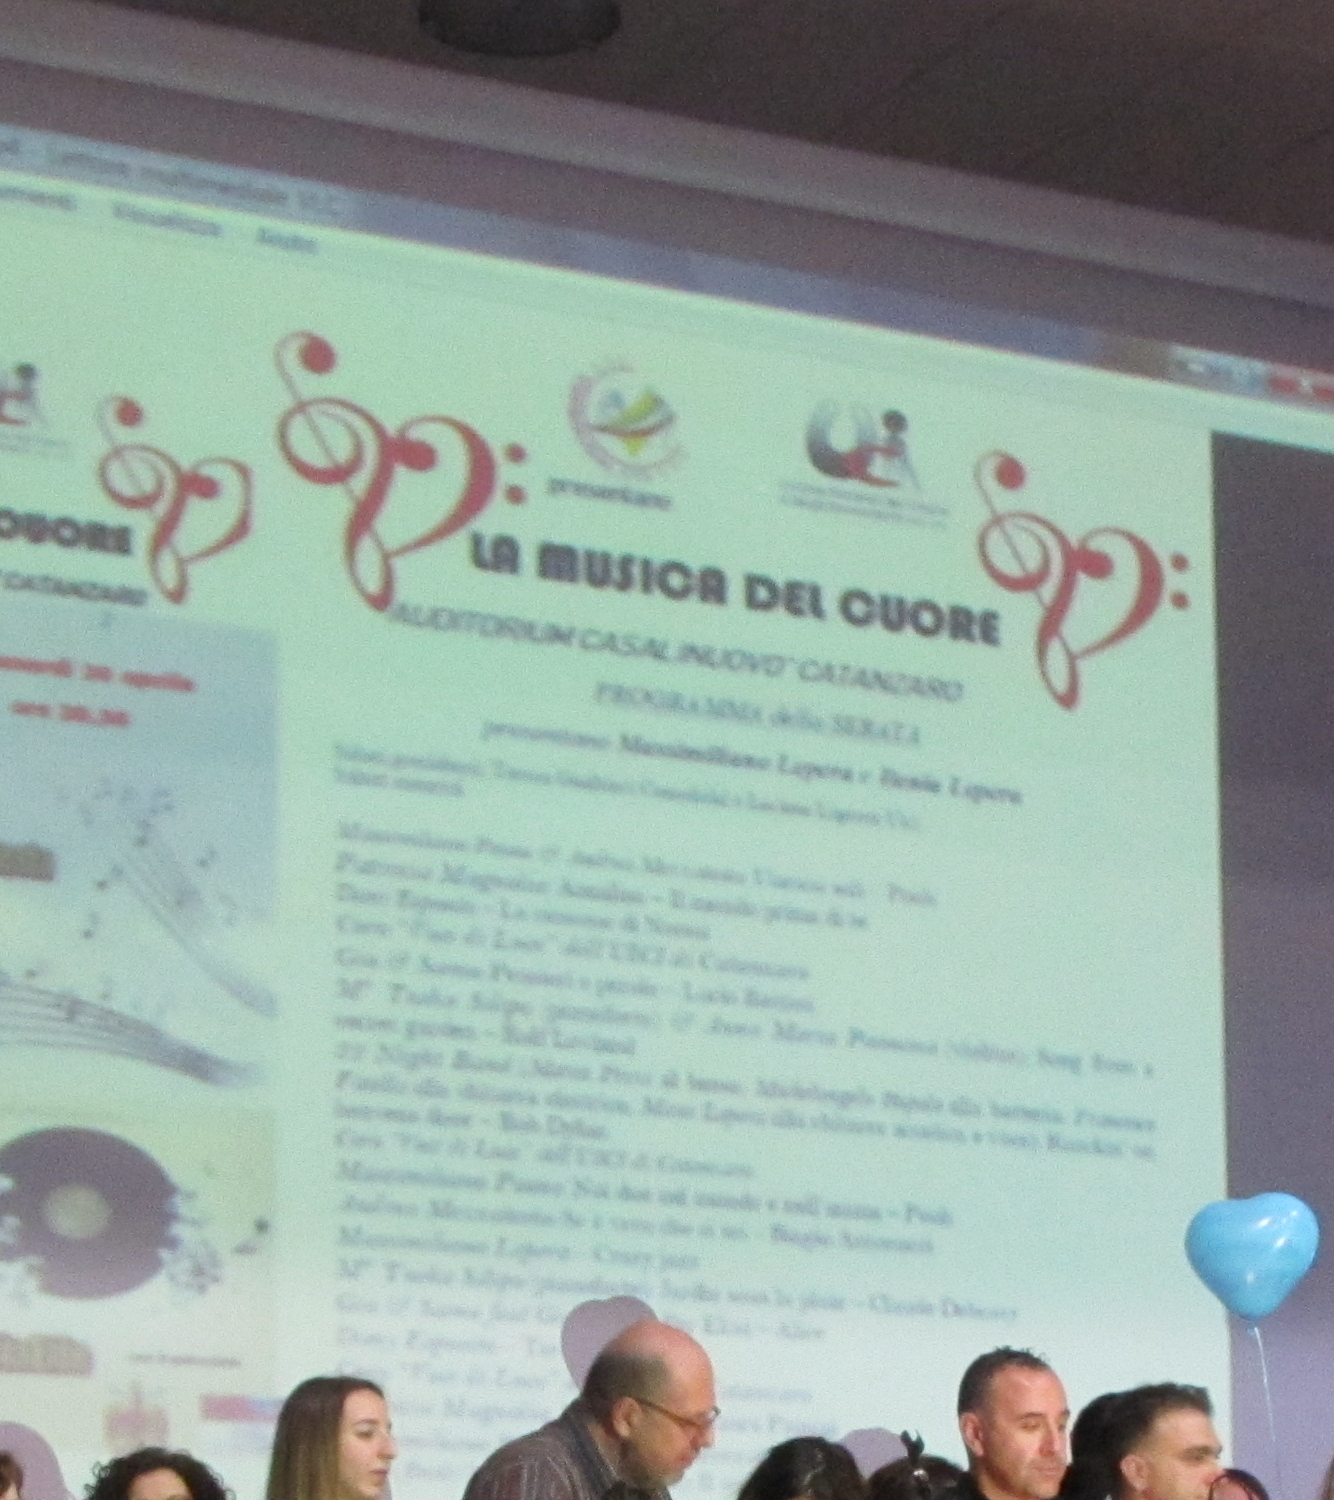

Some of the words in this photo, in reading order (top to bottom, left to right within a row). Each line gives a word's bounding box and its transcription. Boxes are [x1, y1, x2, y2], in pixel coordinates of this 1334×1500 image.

[471, 530, 523, 576] LA
[537, 541, 728, 606] MUSICA
[742, 572, 826, 621] DEL
[838, 588, 1001, 647] CUORE
